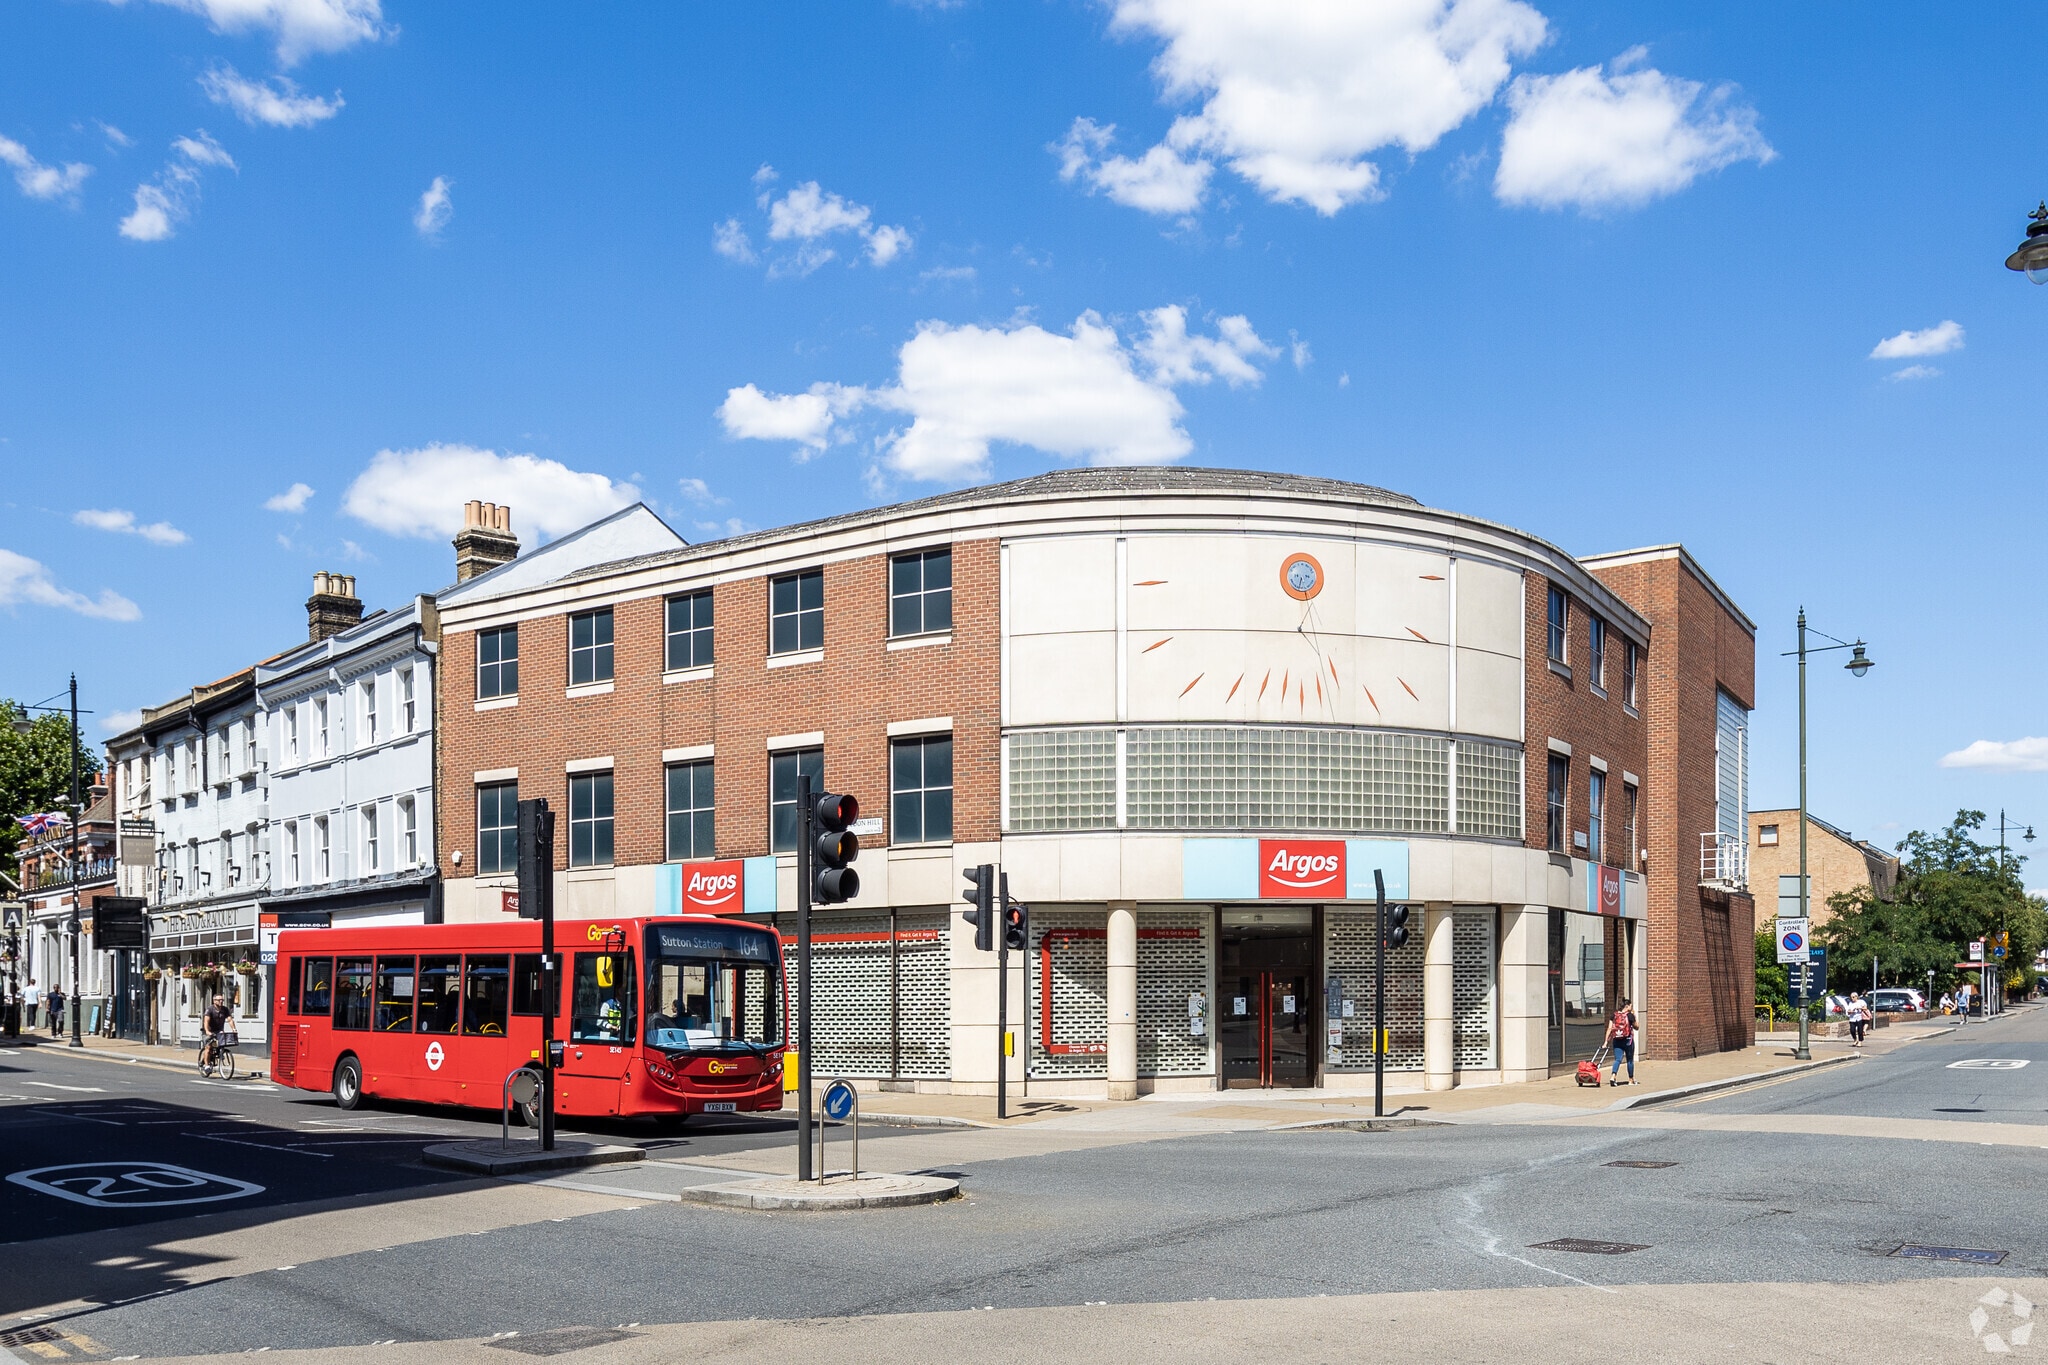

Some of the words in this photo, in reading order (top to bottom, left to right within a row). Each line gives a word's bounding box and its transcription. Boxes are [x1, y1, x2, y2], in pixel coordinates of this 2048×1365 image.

[1268, 849, 1339, 878] Argos
[687, 871, 737, 897] Argos
[1603, 874, 1619, 898] Argos
[507, 896, 519, 907] Arg
[267, 932, 277, 945] T
[662, 935, 692, 948] Sutton
[693, 937, 723, 950] Station
[739, 936, 759, 956] 164
[708, 1060, 725, 1074] Go
[707, 1103, 722, 1111] YX61
[50, 1171, 208, 1197] 20
